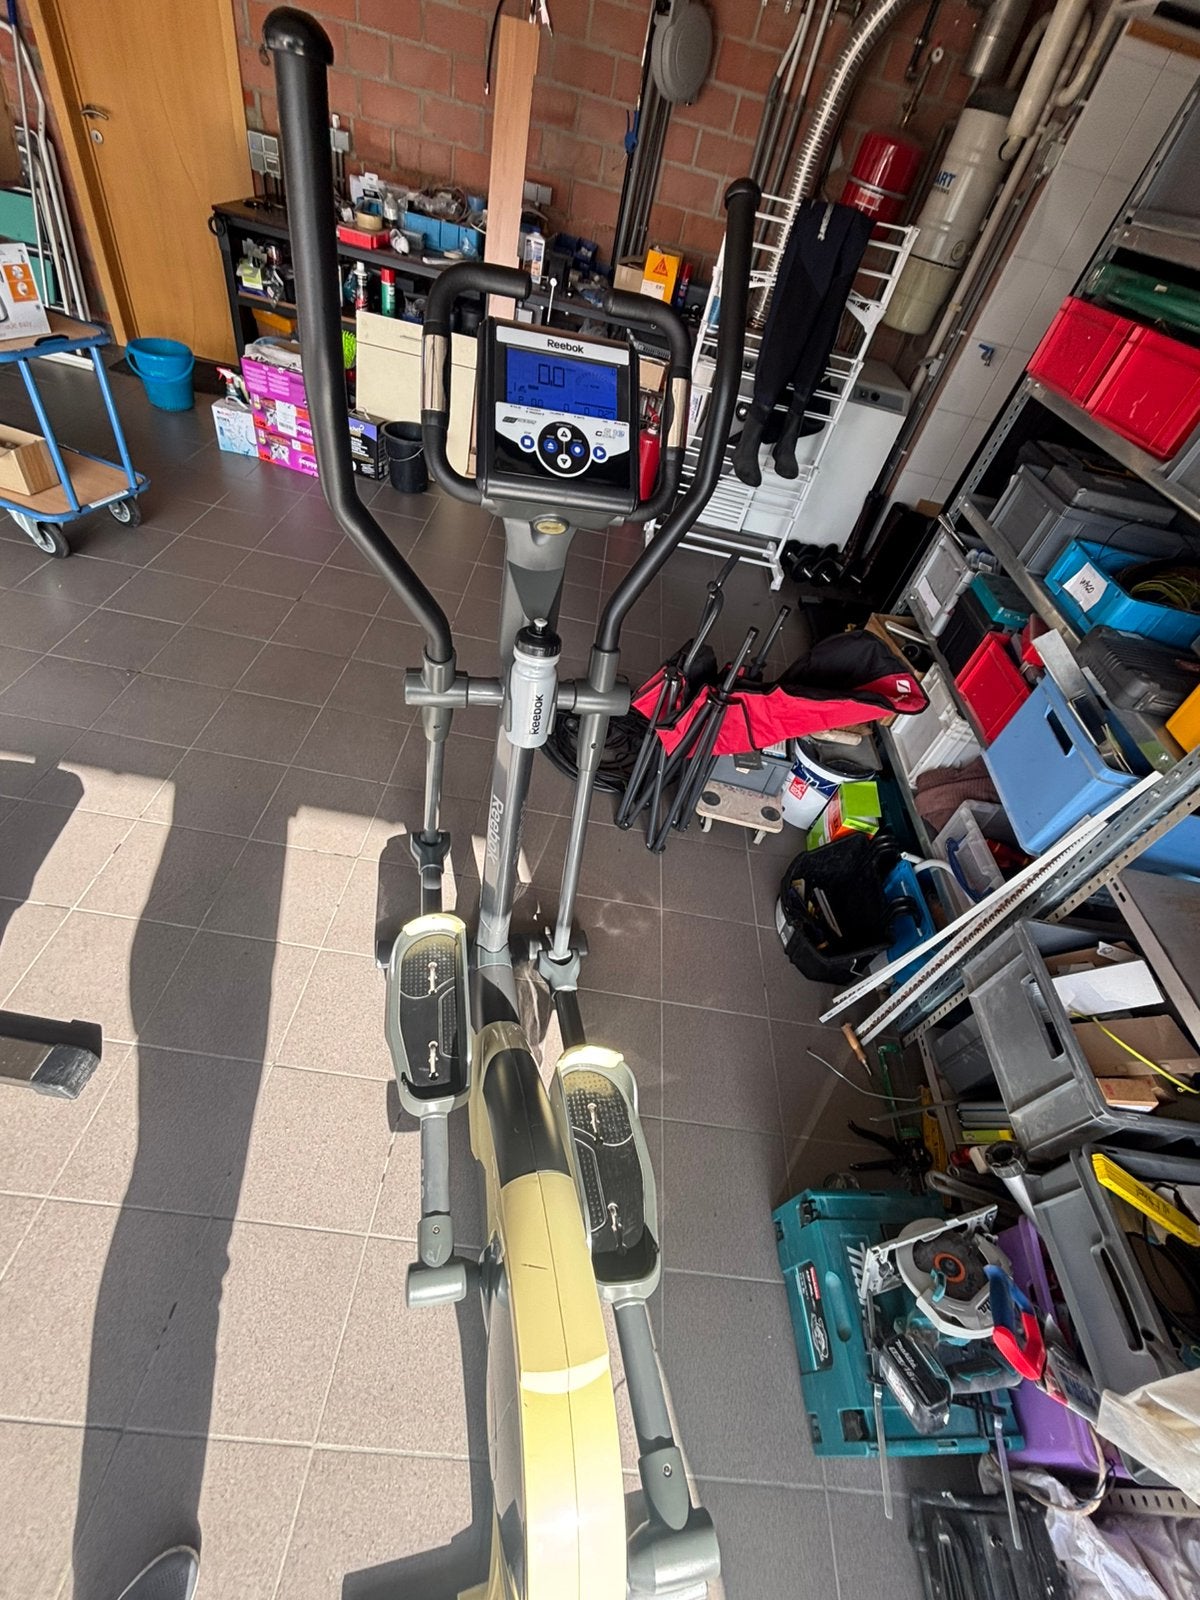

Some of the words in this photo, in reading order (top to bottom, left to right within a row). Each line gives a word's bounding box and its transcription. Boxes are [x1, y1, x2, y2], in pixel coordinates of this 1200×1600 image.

[547, 338, 584, 354] Reebok
[531, 694, 544, 735] Reebok
[487, 794, 504, 865] Reebok
